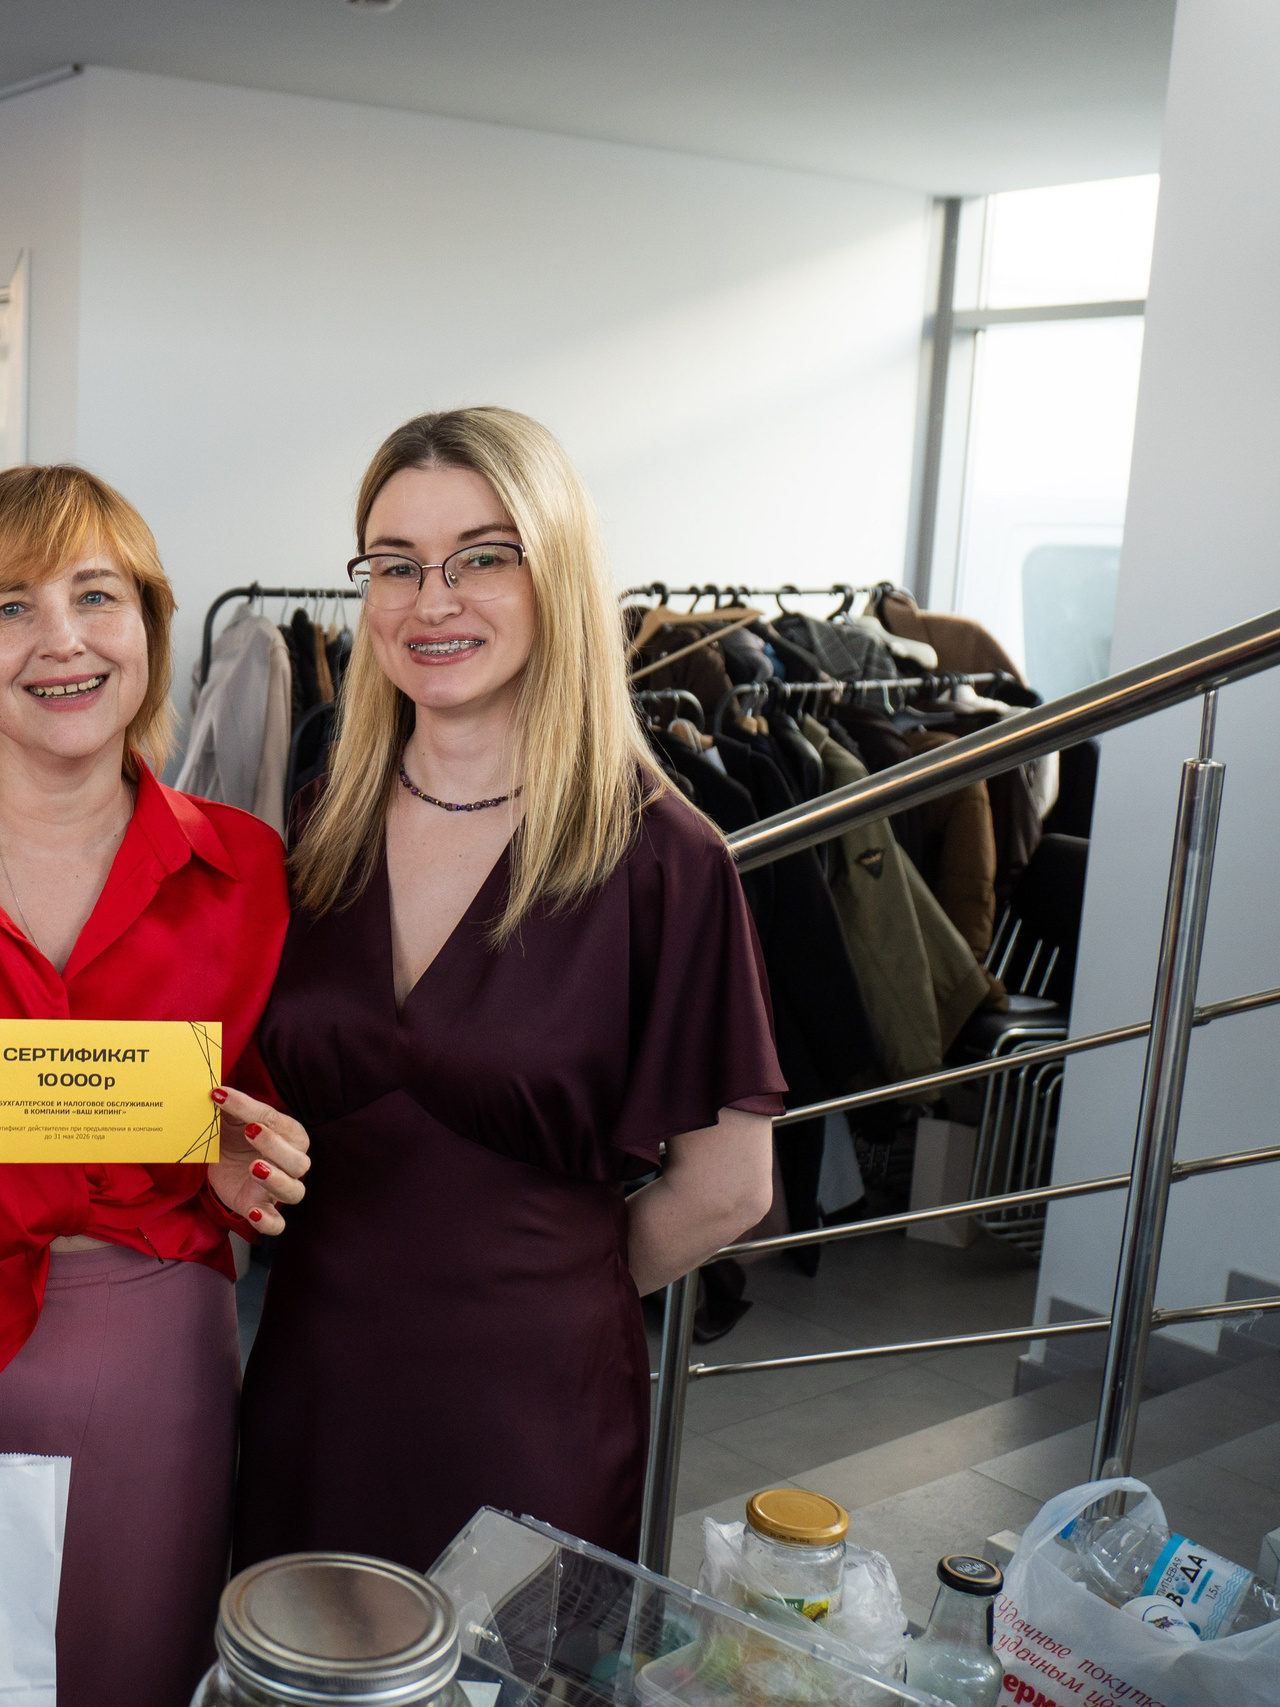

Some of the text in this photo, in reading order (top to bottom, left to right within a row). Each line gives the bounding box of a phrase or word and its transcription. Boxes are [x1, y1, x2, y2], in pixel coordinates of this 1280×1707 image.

[3, 1047, 150, 1063] СЕРТИФИКАТ
[1157, 1556, 1184, 1596] ПИТЬЕВАЯ
[994, 1633, 1085, 1694] удачным
[1077, 1658, 1166, 1707] покупк
